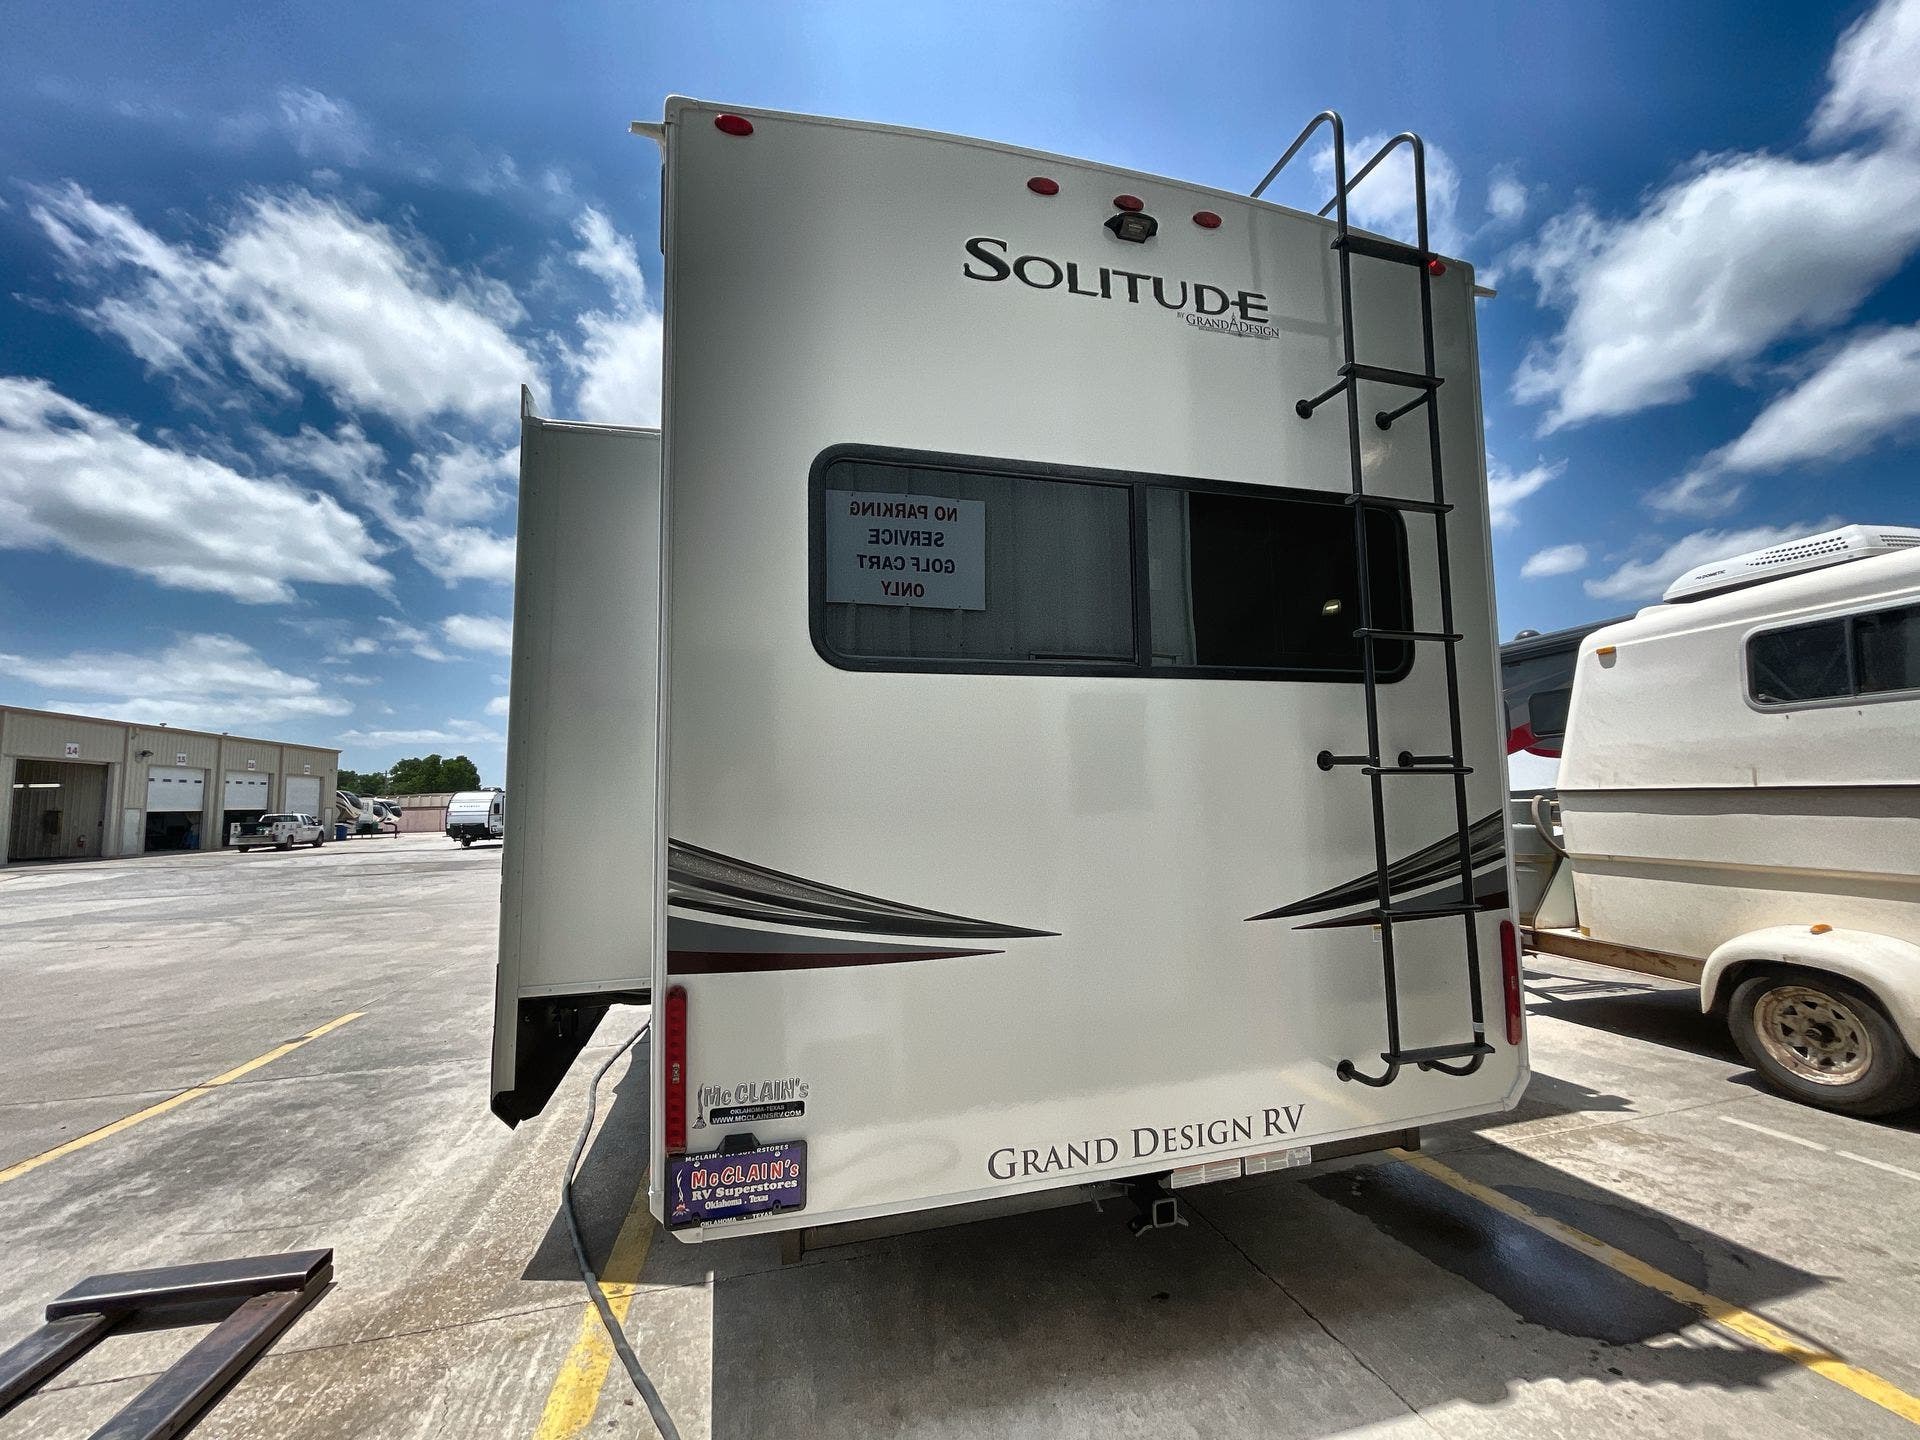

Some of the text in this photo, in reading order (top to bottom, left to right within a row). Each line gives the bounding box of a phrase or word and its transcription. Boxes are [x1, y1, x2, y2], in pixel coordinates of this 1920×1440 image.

[963, 237, 1269, 323] SOLITUDE
[1186, 313, 1230, 331] GRAND
[1240, 321, 1280, 337] DESIGN
[66, 746, 78, 755] 14
[177, 755, 186, 763] 15
[987, 1137, 1118, 1180] GRAND
[1131, 1115, 1252, 1158] DESIGN
[1262, 1103, 1306, 1138] RV
[691, 1179, 798, 1201] RV Superstores
[704, 1194, 769, 1210] Oklahoma Texas
